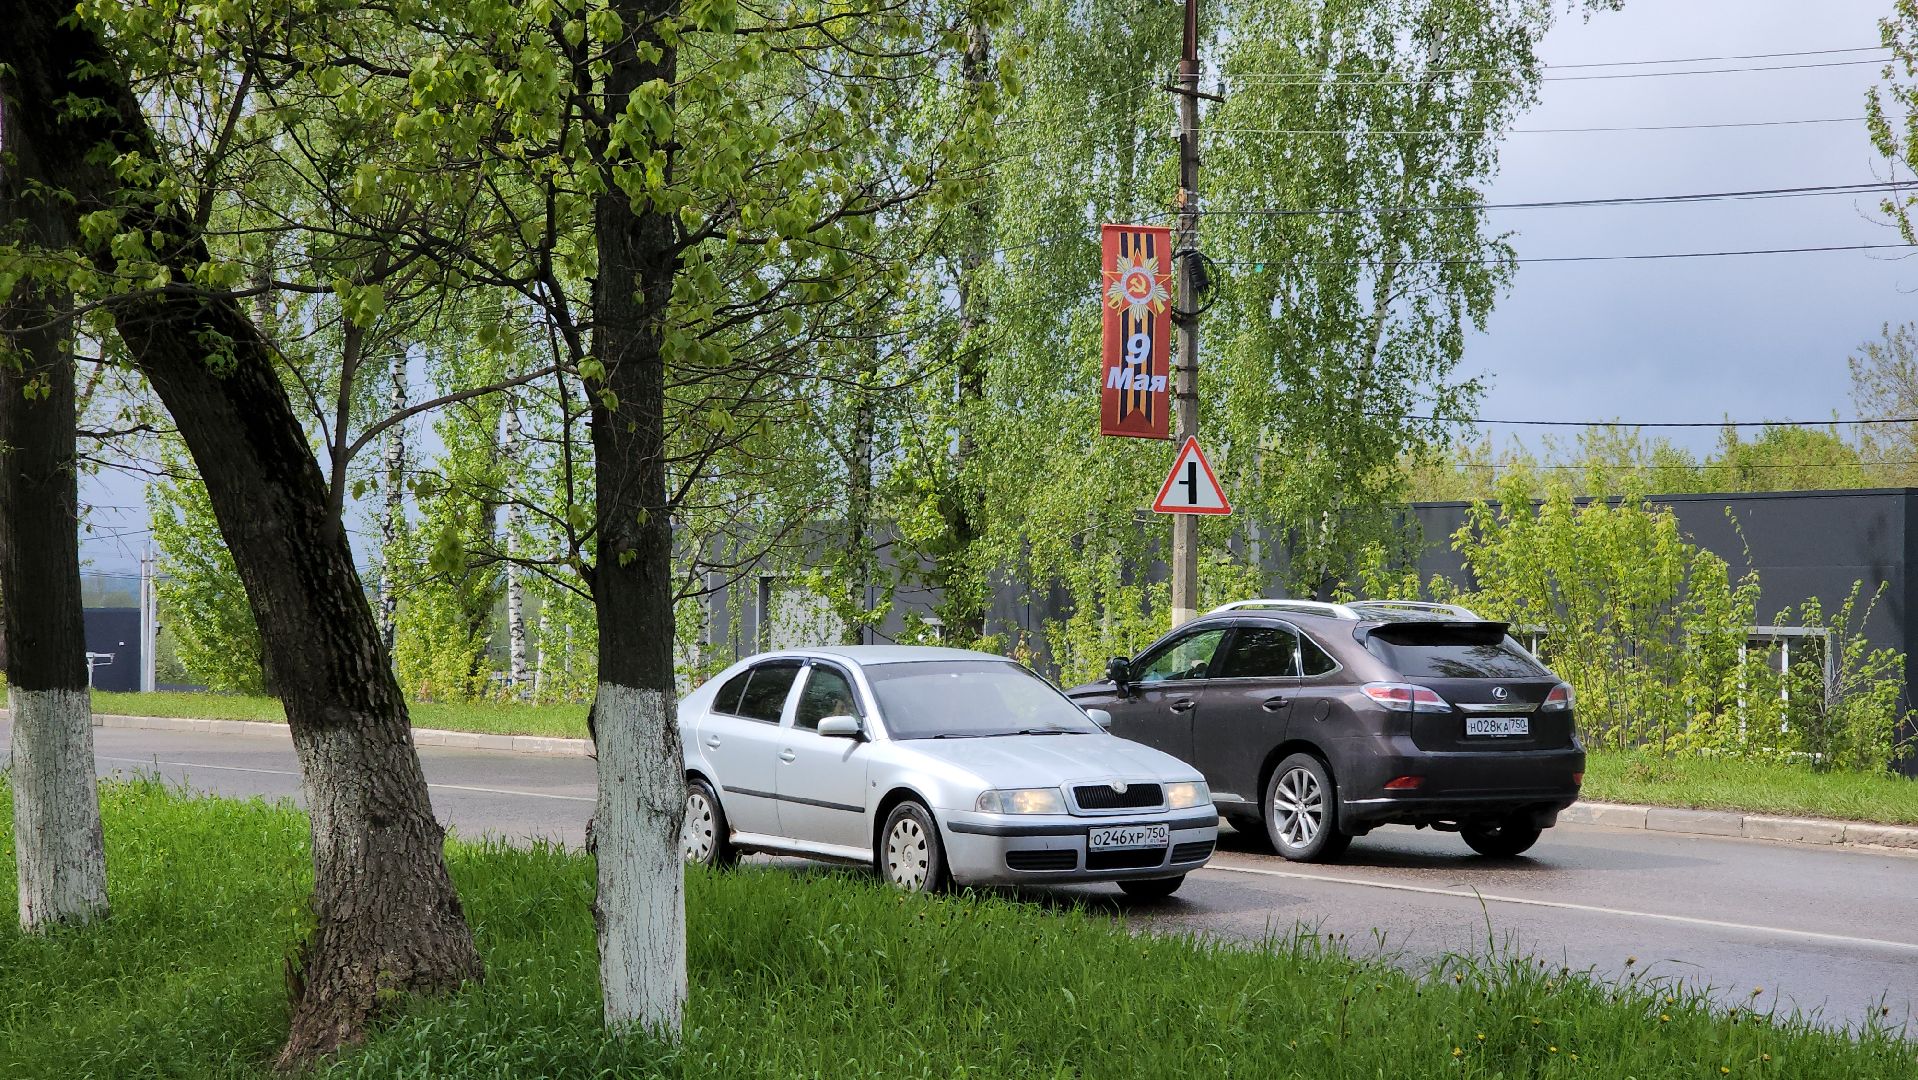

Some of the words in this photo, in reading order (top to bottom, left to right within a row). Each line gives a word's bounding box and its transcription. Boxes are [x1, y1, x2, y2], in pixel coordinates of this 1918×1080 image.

[1125, 333, 1151, 364] 9
[1107, 367, 1168, 392] Мая
[1510, 719, 1526, 729] 750
[1146, 827, 1165, 839] 750
